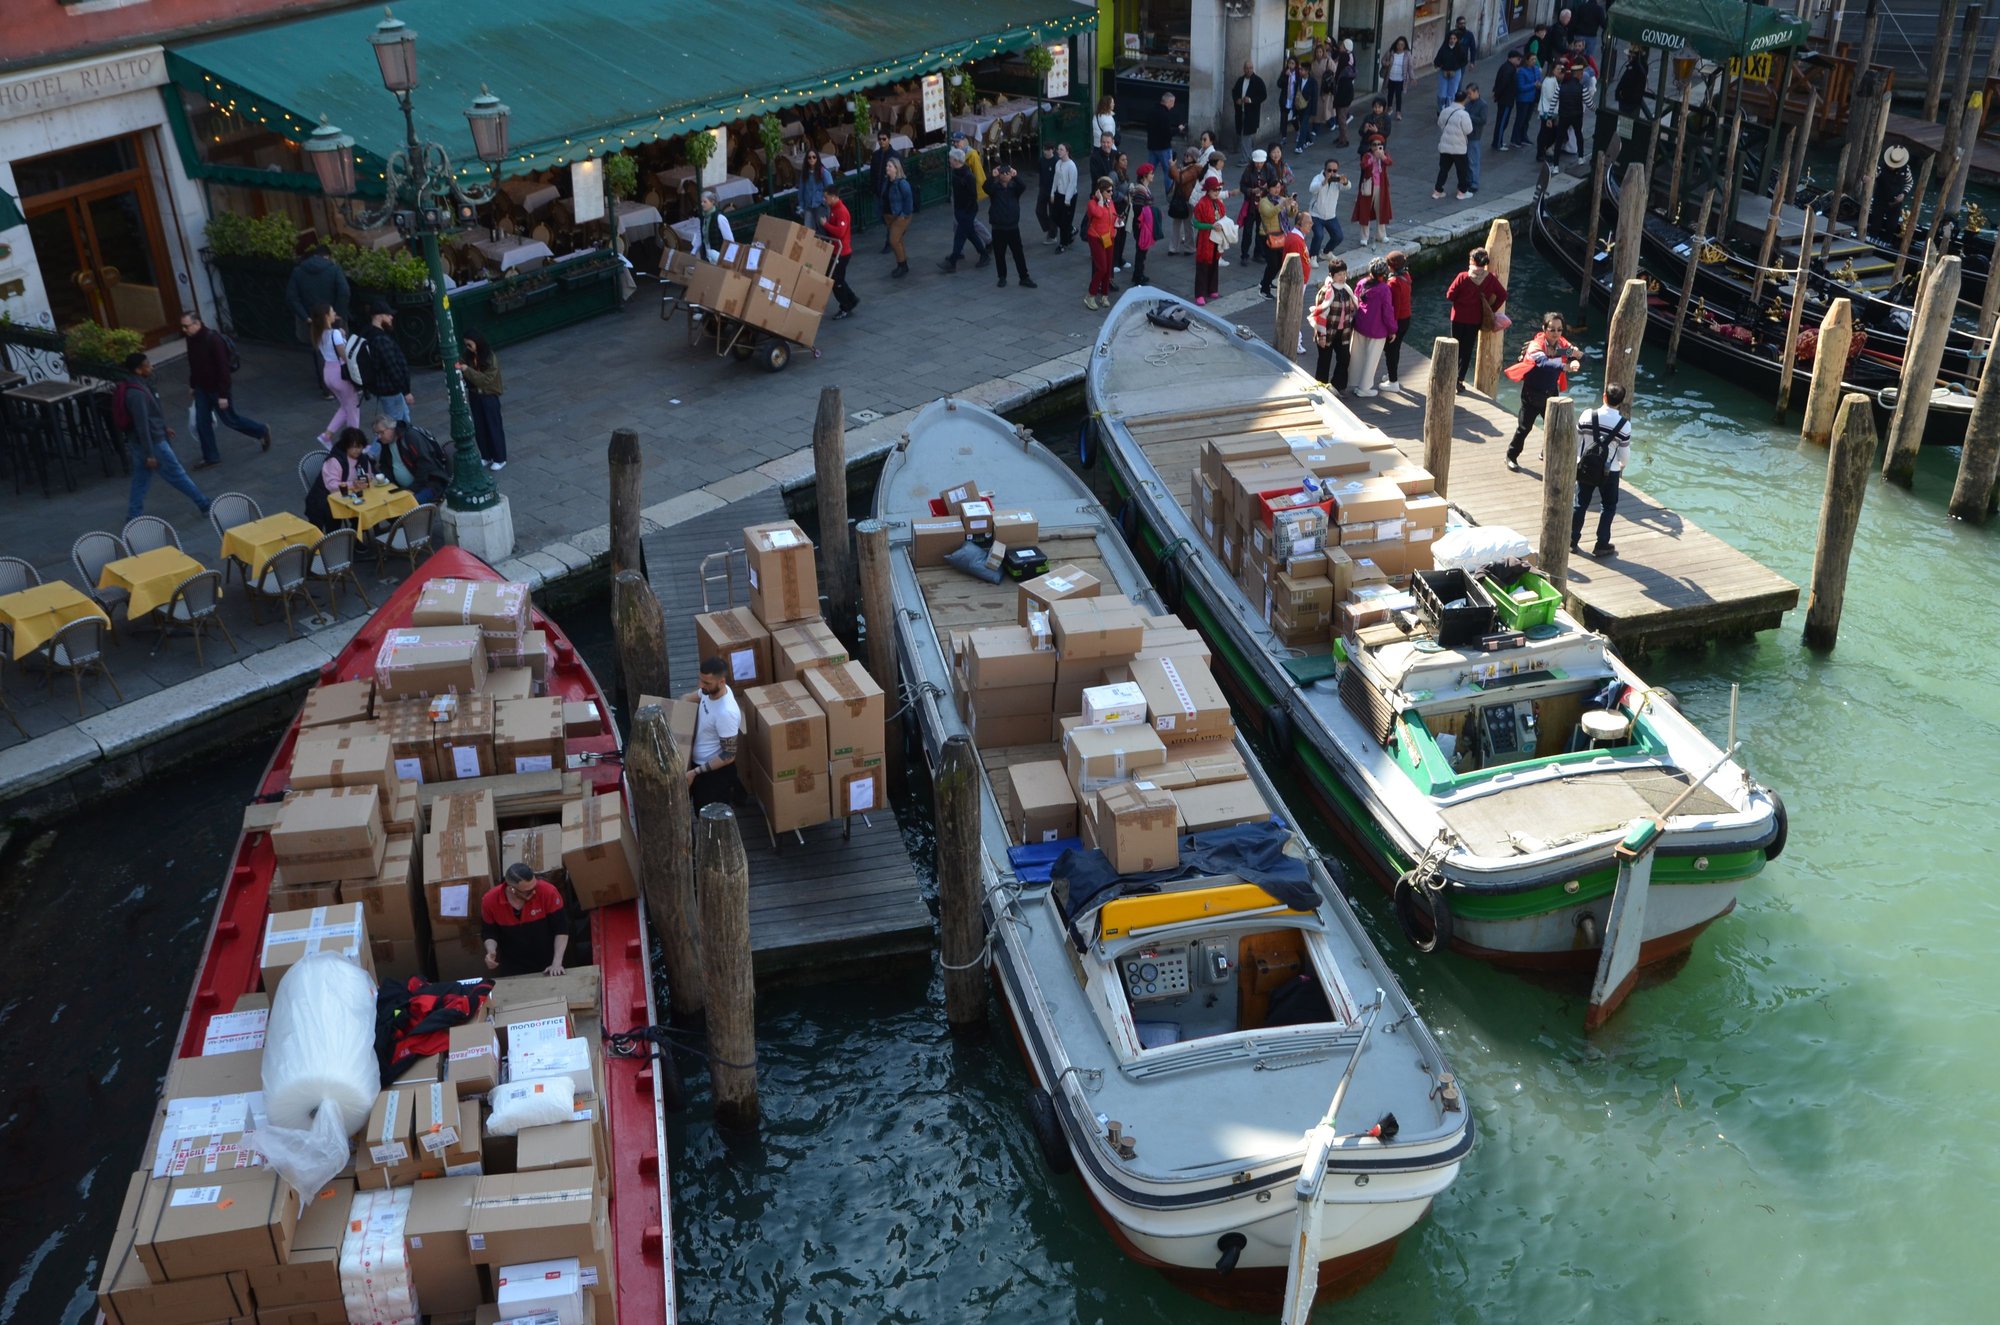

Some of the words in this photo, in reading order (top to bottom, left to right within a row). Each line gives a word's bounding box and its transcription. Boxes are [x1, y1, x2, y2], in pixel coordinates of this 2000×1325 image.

[1641, 28, 1686, 49] GONDOLA
[1750, 30, 1793, 51] GONDOLA
[0, 76, 68, 107] HOTEL
[79, 57, 151, 89] RIALTO
